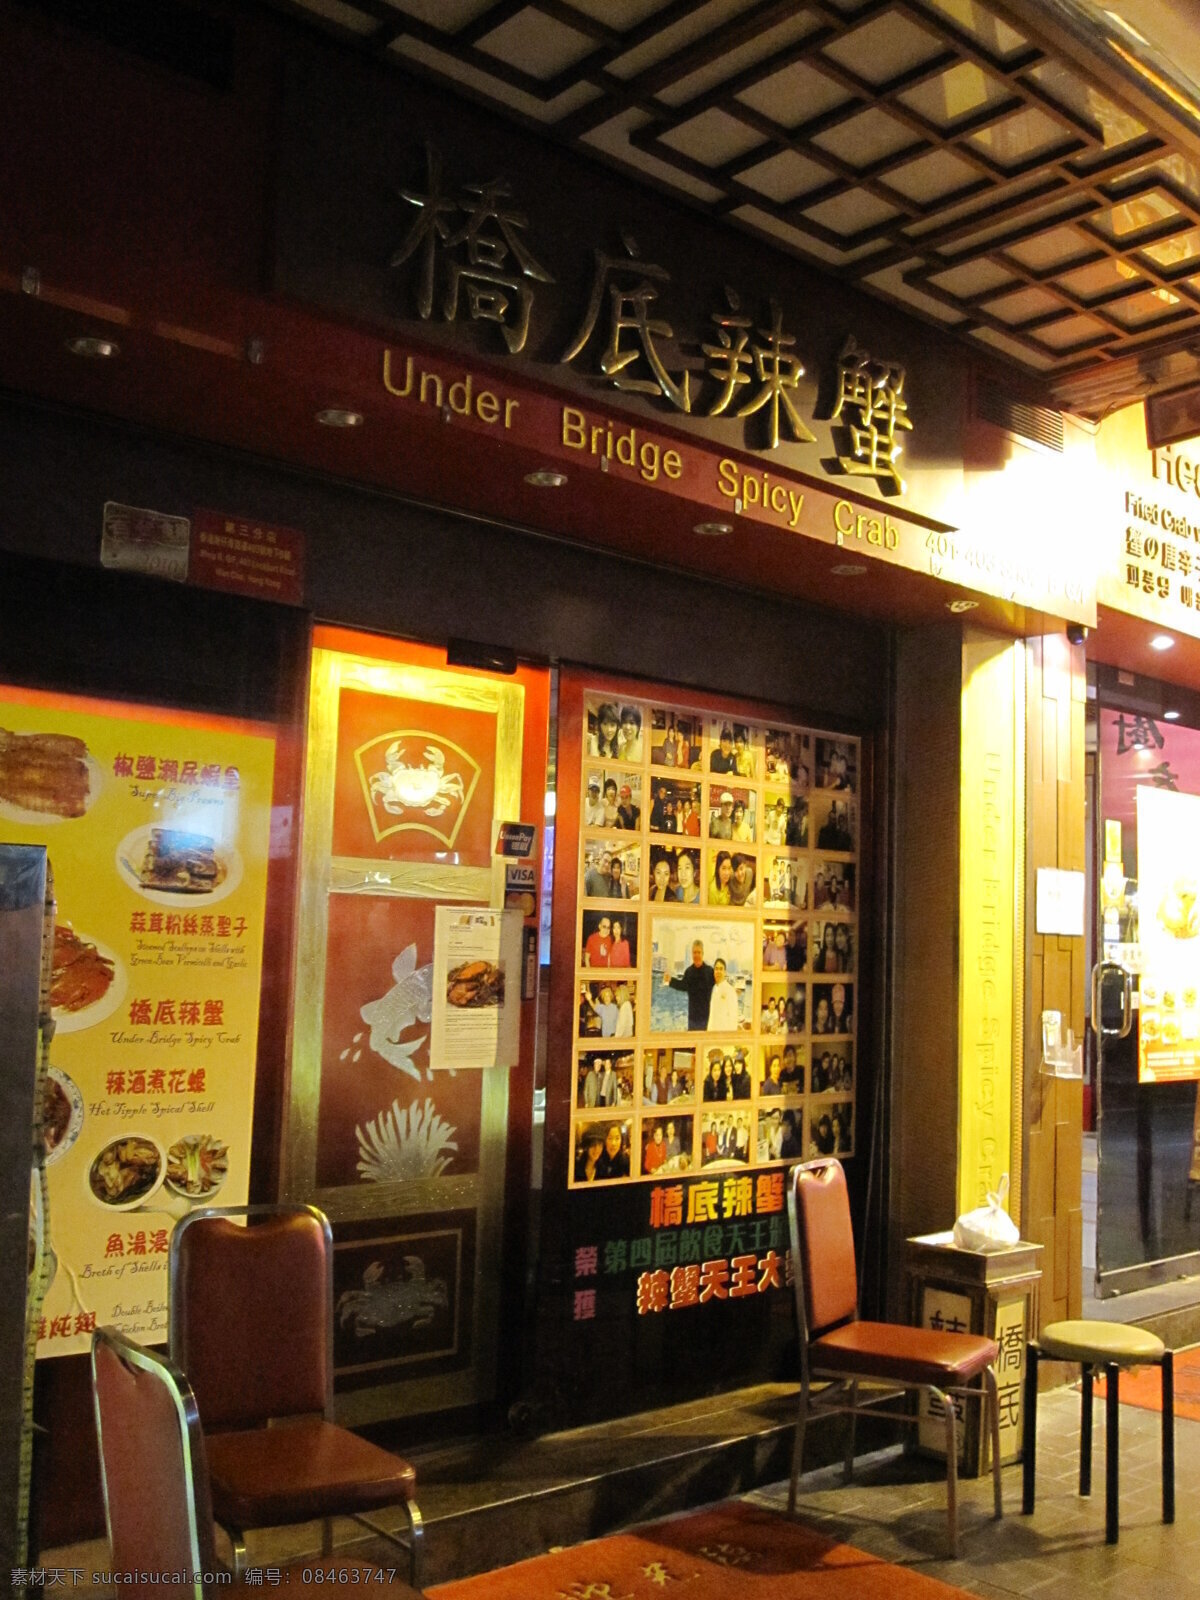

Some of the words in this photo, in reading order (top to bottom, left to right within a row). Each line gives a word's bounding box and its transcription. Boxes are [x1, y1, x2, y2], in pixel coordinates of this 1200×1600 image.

[390, 138, 914, 496] 橋底辣蟹
[383, 348, 520, 429] Under
[562, 405, 684, 483] Bridge
[717, 456, 805, 527] Spicy
[833, 499, 901, 552] Crab
[511, 867, 534, 881] VISA
[129, 998, 224, 1026] 橋底辣蟹
[110, 1031, 144, 1044] Under
[147, 1030, 182, 1047] Bridge
[185, 1032, 213, 1048] Spicy
[216, 1032, 243, 1044] Crab
[105, 1068, 206, 1095] 辣酒煮花螺
[977, 1136, 997, 1211] Cra
[649, 1173, 784, 1228] 橋底辣蟹
[79, 1263, 114, 1278] Broth
